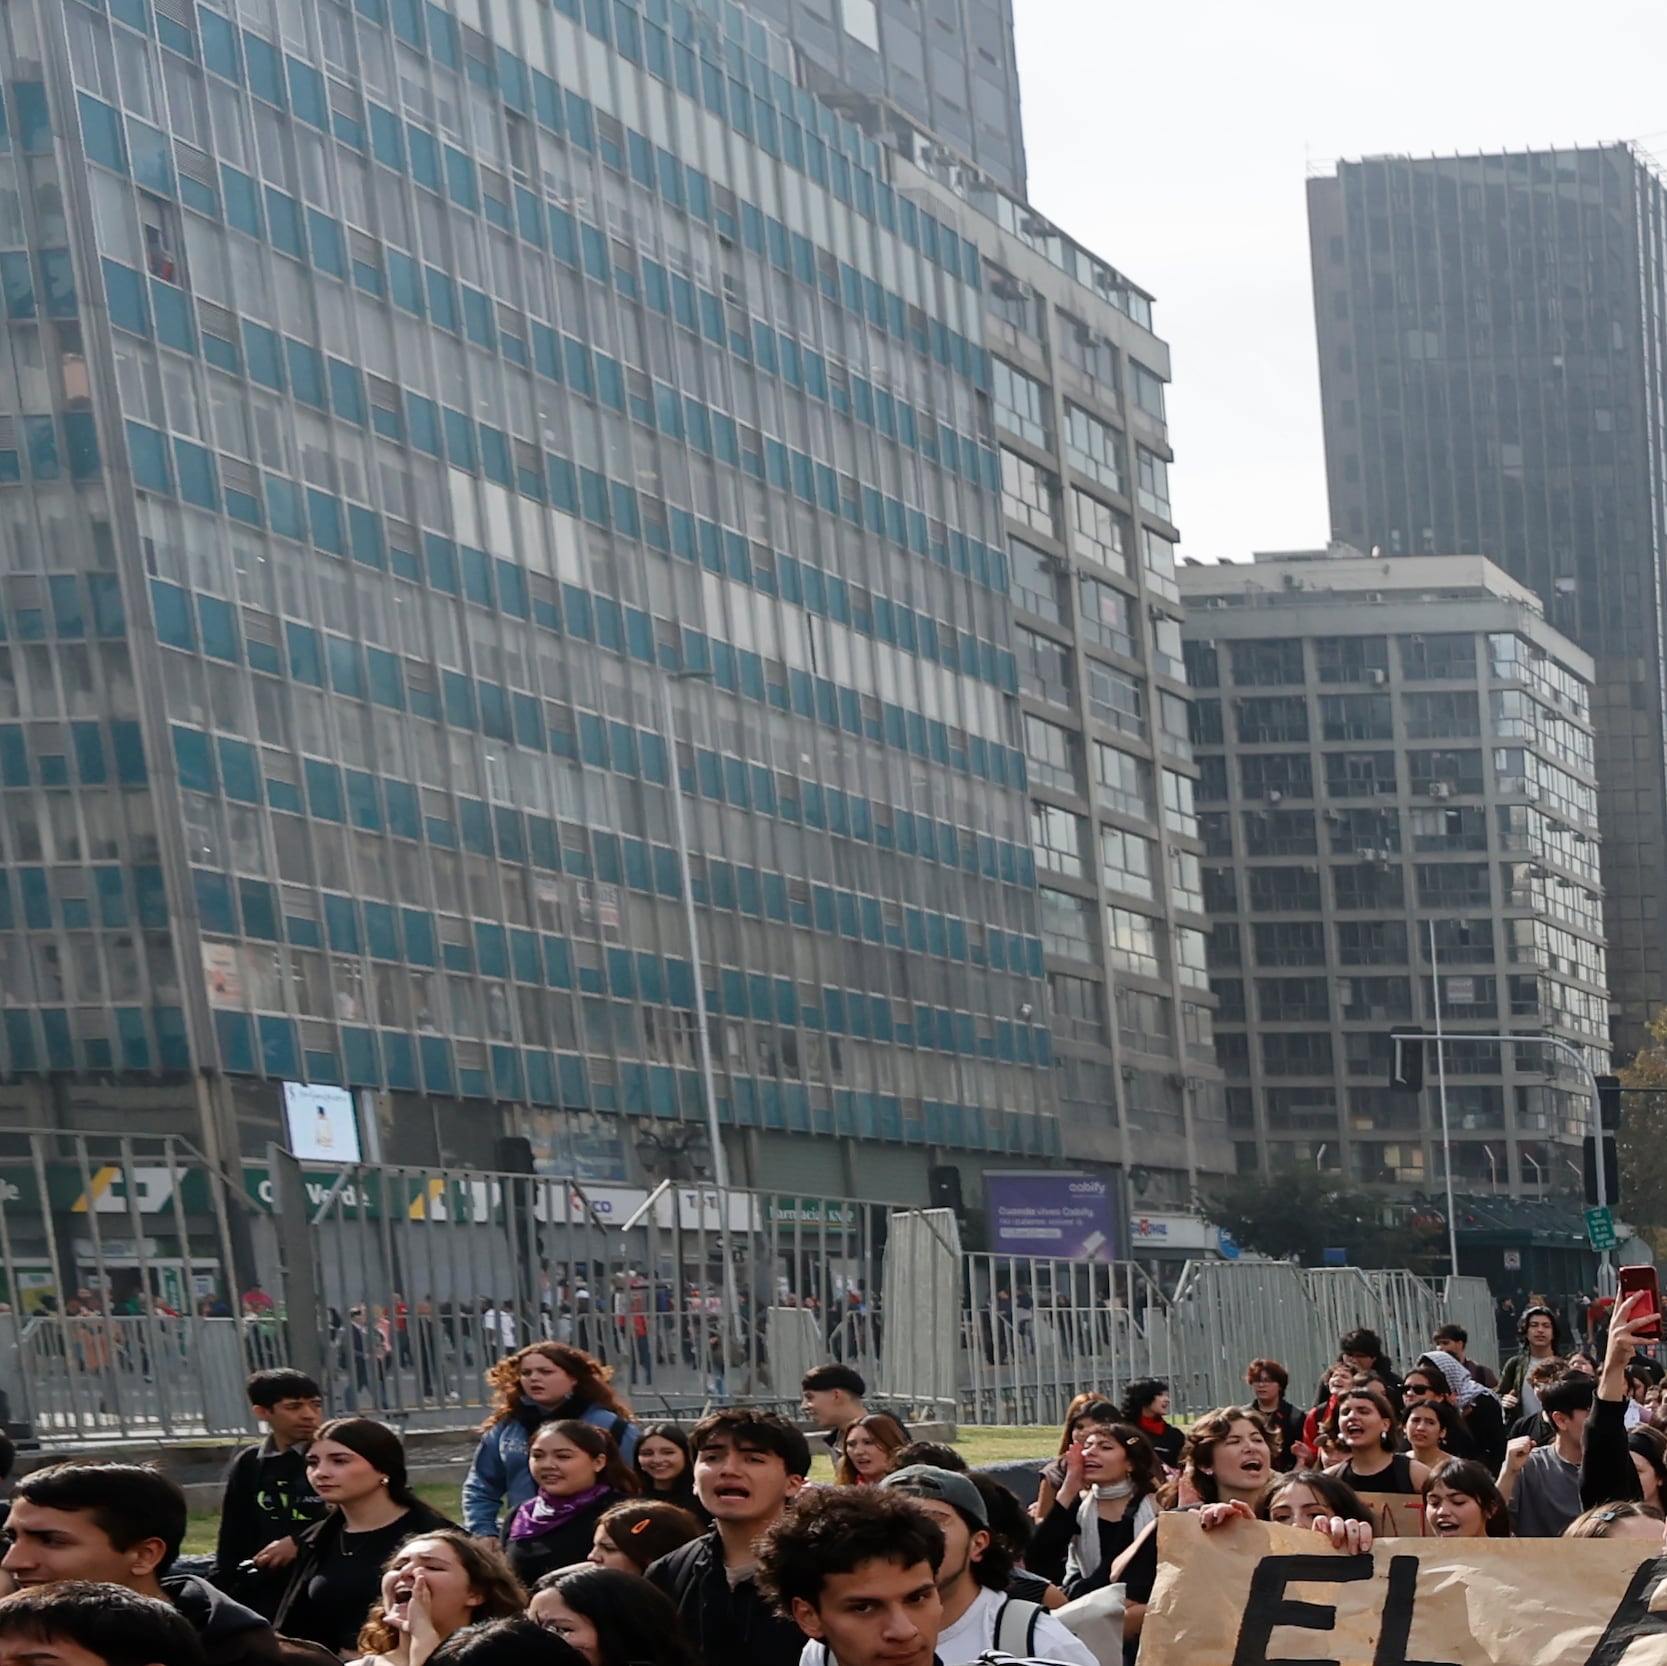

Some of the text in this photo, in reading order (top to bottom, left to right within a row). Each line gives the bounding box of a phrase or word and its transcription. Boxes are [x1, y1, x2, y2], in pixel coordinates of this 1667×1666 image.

[1069, 1182, 1105, 1194] cabify
[305, 1183, 374, 1208] Vede
[828, 1209, 855, 1222] KNP
